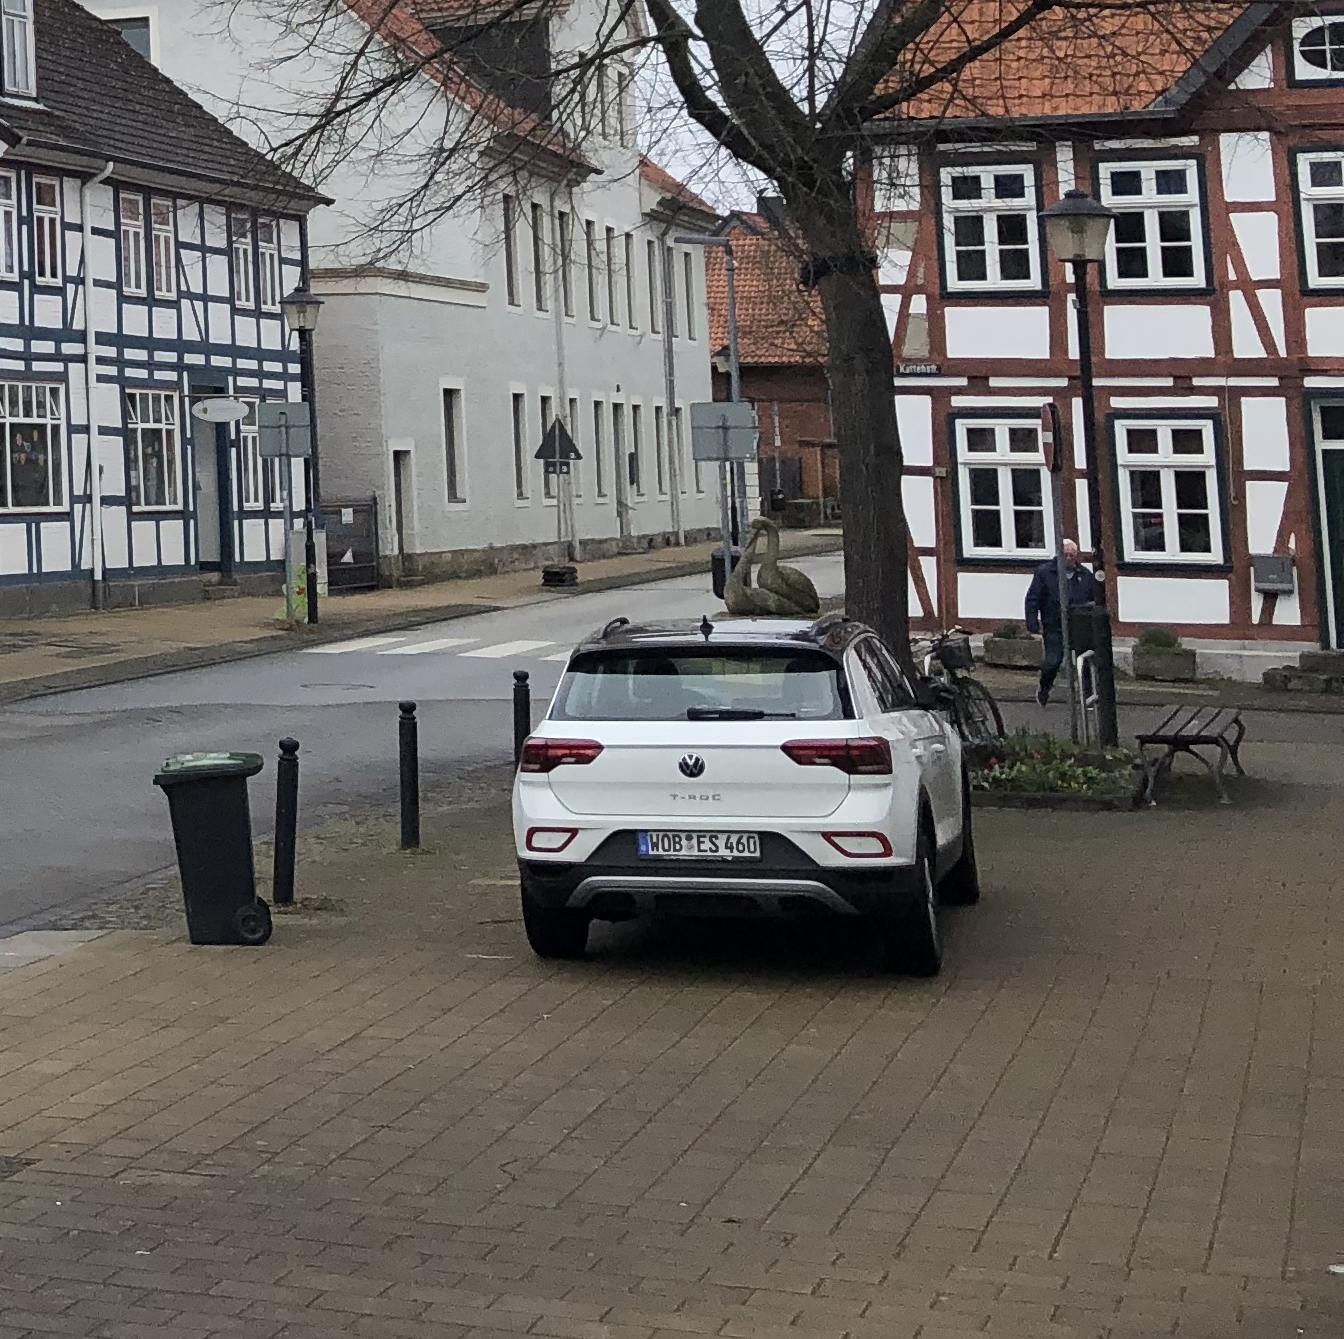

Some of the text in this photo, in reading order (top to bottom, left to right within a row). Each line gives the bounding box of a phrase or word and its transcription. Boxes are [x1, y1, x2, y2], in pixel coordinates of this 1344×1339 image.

[670, 793, 721, 801] T-ROC
[649, 833, 757, 854] WOB ES 460
